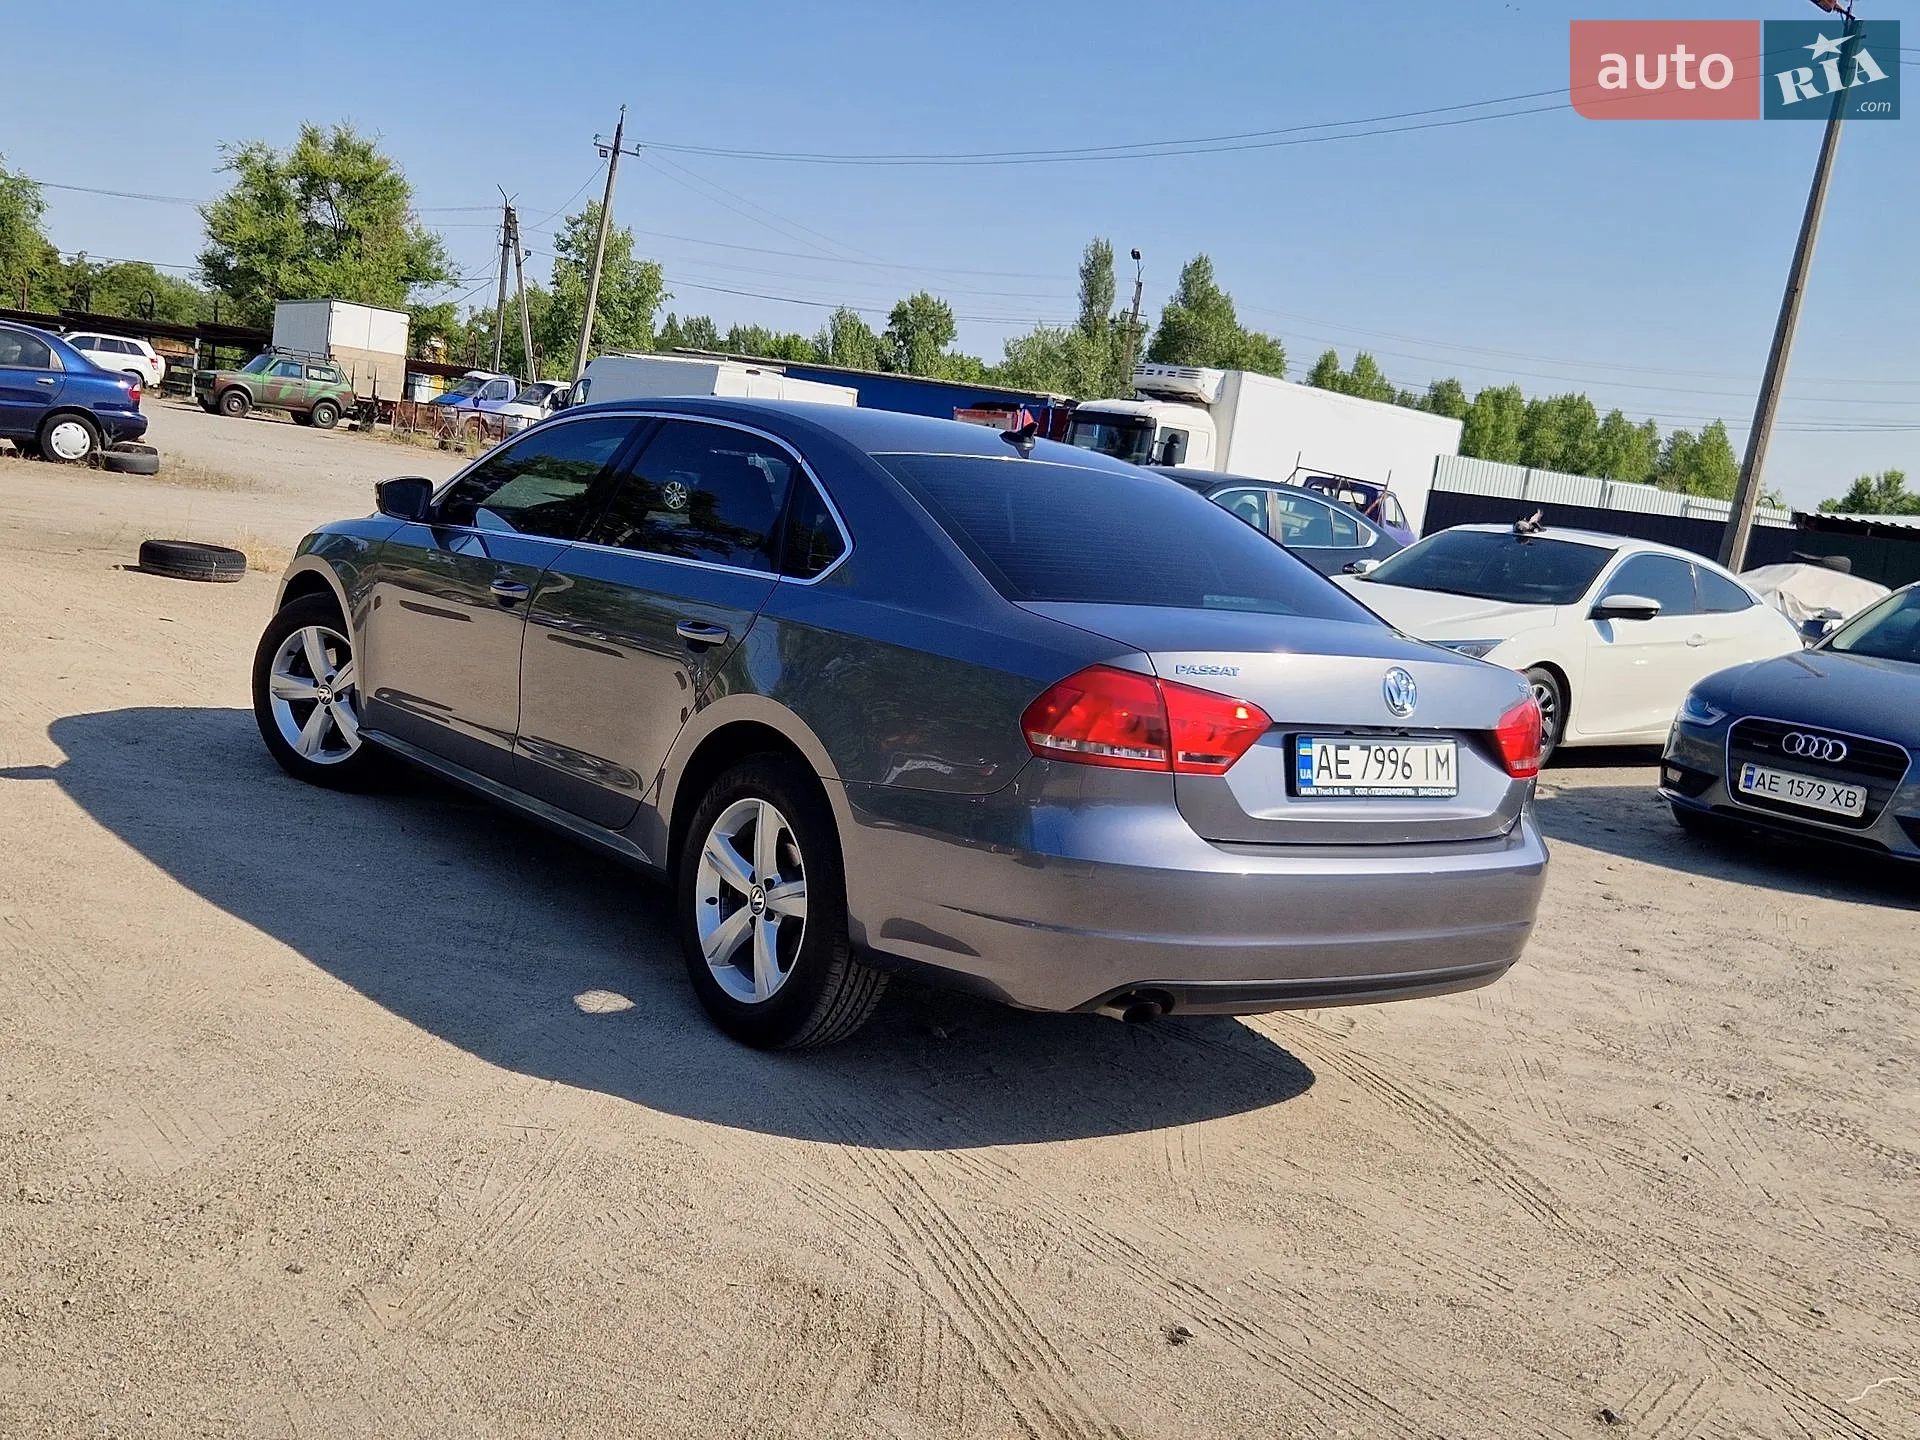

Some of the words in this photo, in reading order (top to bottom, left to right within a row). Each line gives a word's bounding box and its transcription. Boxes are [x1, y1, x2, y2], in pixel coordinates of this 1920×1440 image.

[1175, 664, 1240, 677] PASSAT
[1300, 768, 1312, 780] UA
[1316, 745, 1352, 780] AE
[1359, 745, 1413, 780] 7996
[1425, 747, 1450, 781] IM
[1755, 772, 1781, 793] AE
[1787, 778, 1827, 801] 1579
[1830, 787, 1858, 808] XB
